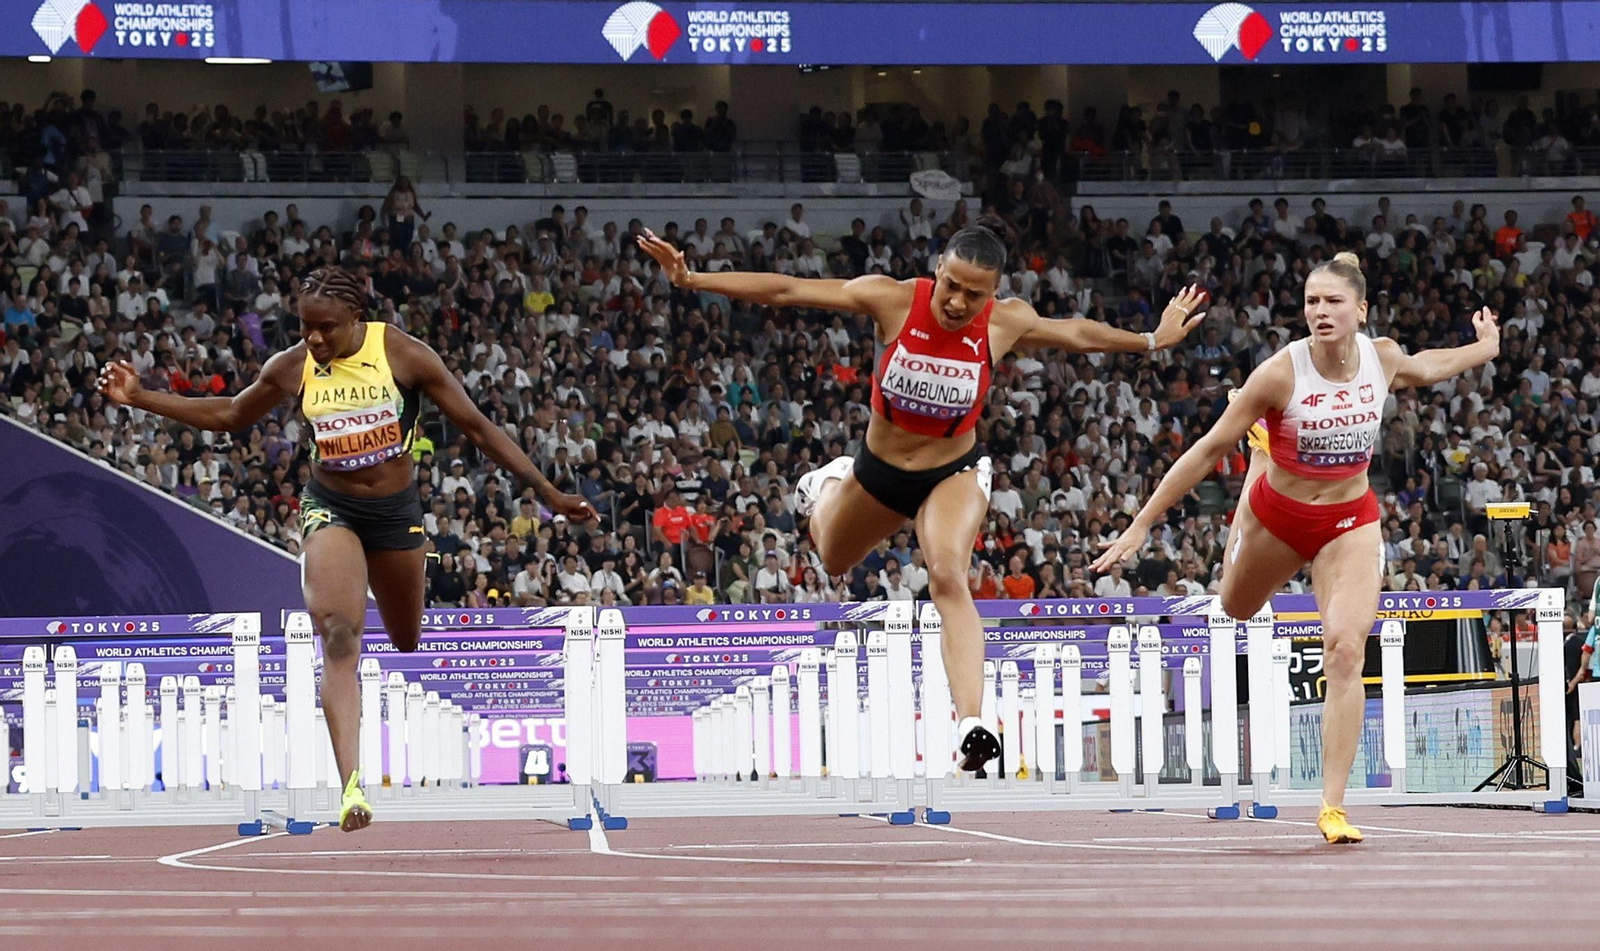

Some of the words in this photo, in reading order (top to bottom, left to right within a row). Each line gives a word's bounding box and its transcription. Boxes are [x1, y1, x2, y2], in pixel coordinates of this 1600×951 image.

[114, 3, 154, 17] WORLD
[155, 4, 214, 17] ATHLETICS
[687, 11, 728, 23] WORLD
[730, 11, 789, 23] ATHLETICS
[1279, 11, 1322, 23] WORLD
[1323, 11, 1385, 23] ATHLETICS
[114, 17, 214, 31] CHAMPIONSHIPS
[687, 24, 790, 37] CHAMPIONSHIPS
[1279, 24, 1386, 37] CHAMPIONSHIPS
[894, 354, 976, 381] HONDA
[886, 370, 973, 405] KAMBUNDJI
[312, 385, 391, 405] JAMAICA
[1331, 403, 1353, 411] ORLEN
[315, 408, 395, 432] HONDA
[1301, 411, 1379, 431] HONDA
[320, 425, 398, 457] WILLIAMS
[1384, 597, 1462, 608] OKYO25
[420, 614, 494, 625] OKYO25
[1003, 630, 1086, 640] CHAMPIONSHIPS
[1182, 628, 1211, 637] WORL
[1277, 626, 1324, 634] CHAMPIO
[367, 643, 398, 652] WORL
[417, 642, 458, 651] HLETICS
[461, 641, 543, 650] CHAMPIONSHIPS
[637, 638, 674, 647] WORLD
[676, 637, 729, 646] ATHLETICS
[732, 635, 814, 645] CHAMPIONSHIPS
[96, 648, 132, 657] WORLD
[135, 647, 187, 656] ATHLETICS
[1162, 645, 1209, 653] OKYO2
[420, 673, 447, 681] WORLD
[449, 672, 489, 680] ATHLETICS
[491, 671, 554, 679] CHAMPIONSHIPS
[694, 668, 757, 676] CHAMPIONSHIPS
[259, 676, 284, 684] LETICS
[524, 750, 550, 775] 4
[630, 751, 650, 771] 3
